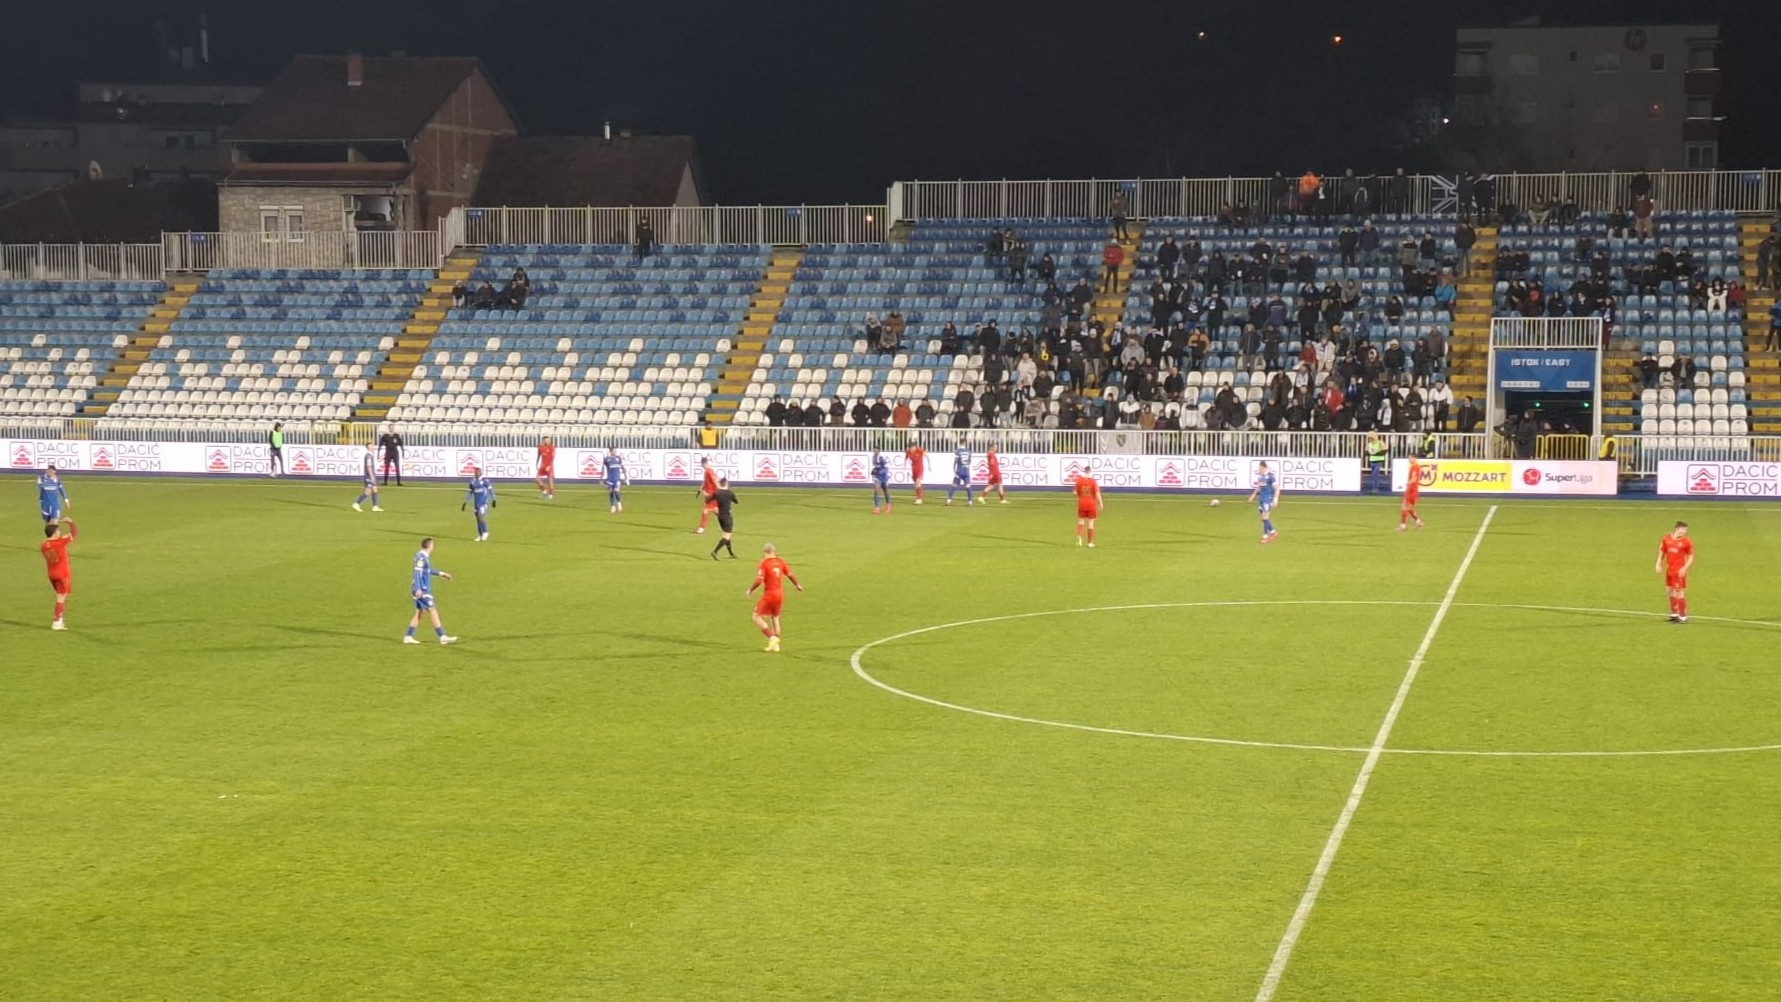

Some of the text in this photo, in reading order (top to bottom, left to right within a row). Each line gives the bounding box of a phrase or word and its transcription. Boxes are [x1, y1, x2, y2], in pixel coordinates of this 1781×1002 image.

[117, 458, 162, 471] PROM
[316, 463, 361, 475] PROM
[402, 465, 446, 477] PROM
[485, 466, 531, 477] PROM
[782, 469, 830, 482] PROM
[1442, 472, 1507, 482] MOZZART
[999, 473, 1049, 485] PROM
[1187, 475, 1238, 488] PROM
[1282, 476, 1334, 489] PROM
[1545, 472, 1593, 484] SuperLiga
[1721, 481, 1778, 495] PROM
[773, 567, 780, 578] 7
